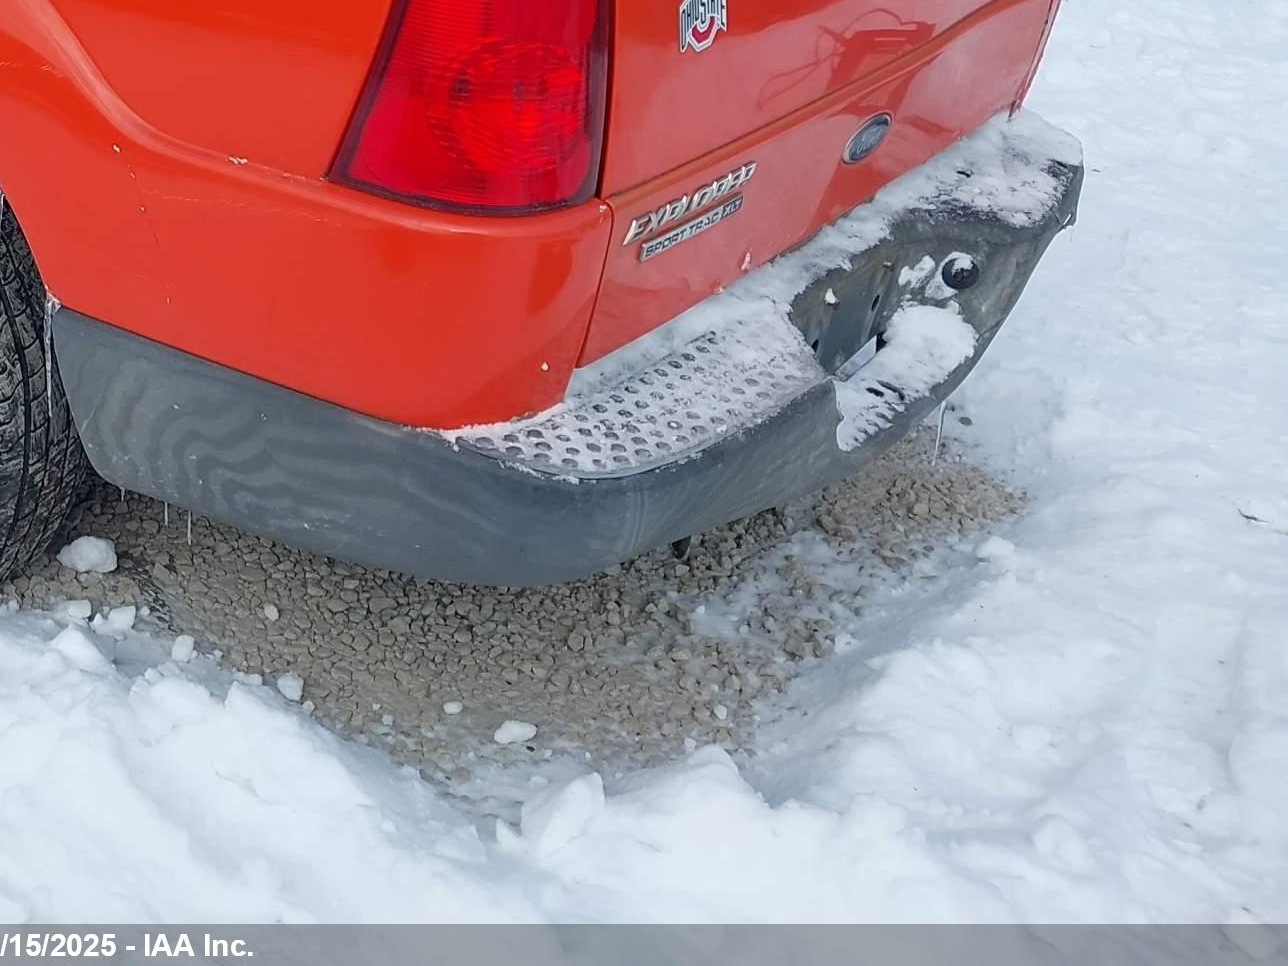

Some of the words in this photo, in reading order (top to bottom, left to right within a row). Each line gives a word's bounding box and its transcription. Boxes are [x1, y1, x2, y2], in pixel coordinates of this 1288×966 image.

[644, 229, 689, 258] SPORT
[688, 211, 721, 236] TRAC
[721, 198, 743, 221] XLT
